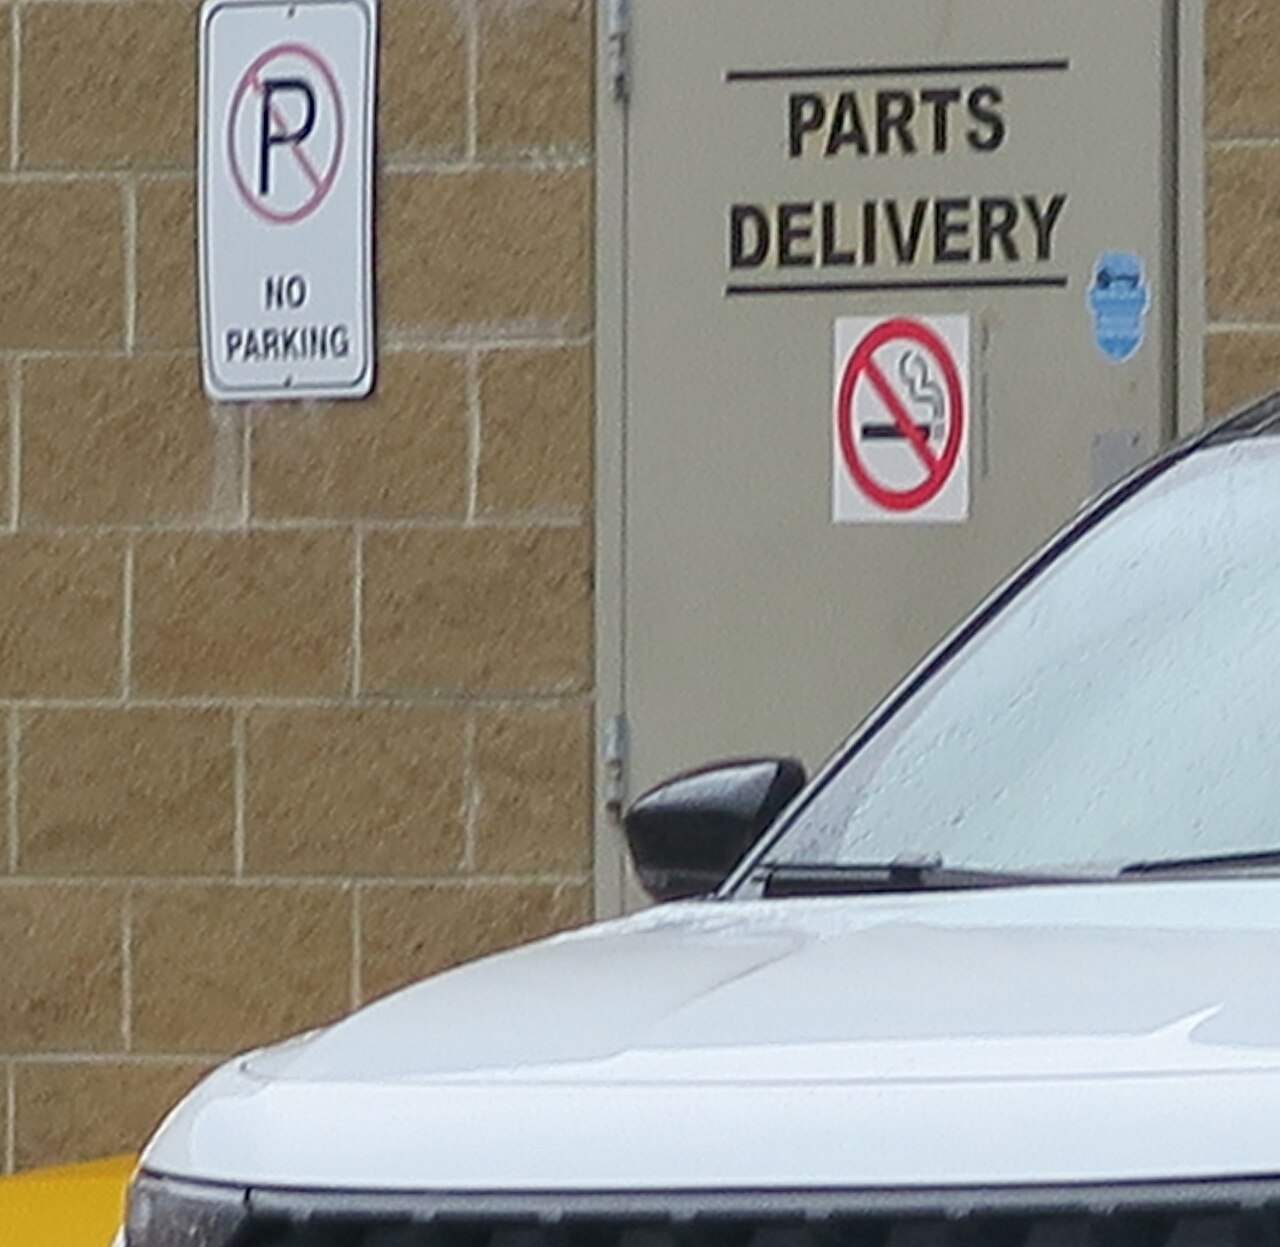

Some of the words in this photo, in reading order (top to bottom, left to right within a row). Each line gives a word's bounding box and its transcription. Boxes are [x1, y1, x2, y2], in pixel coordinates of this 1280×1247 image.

[787, 85, 1007, 159] PARTS
[729, 193, 1069, 270] DELIVERY
[263, 275, 307, 311] NO
[225, 323, 350, 364] PARKING
